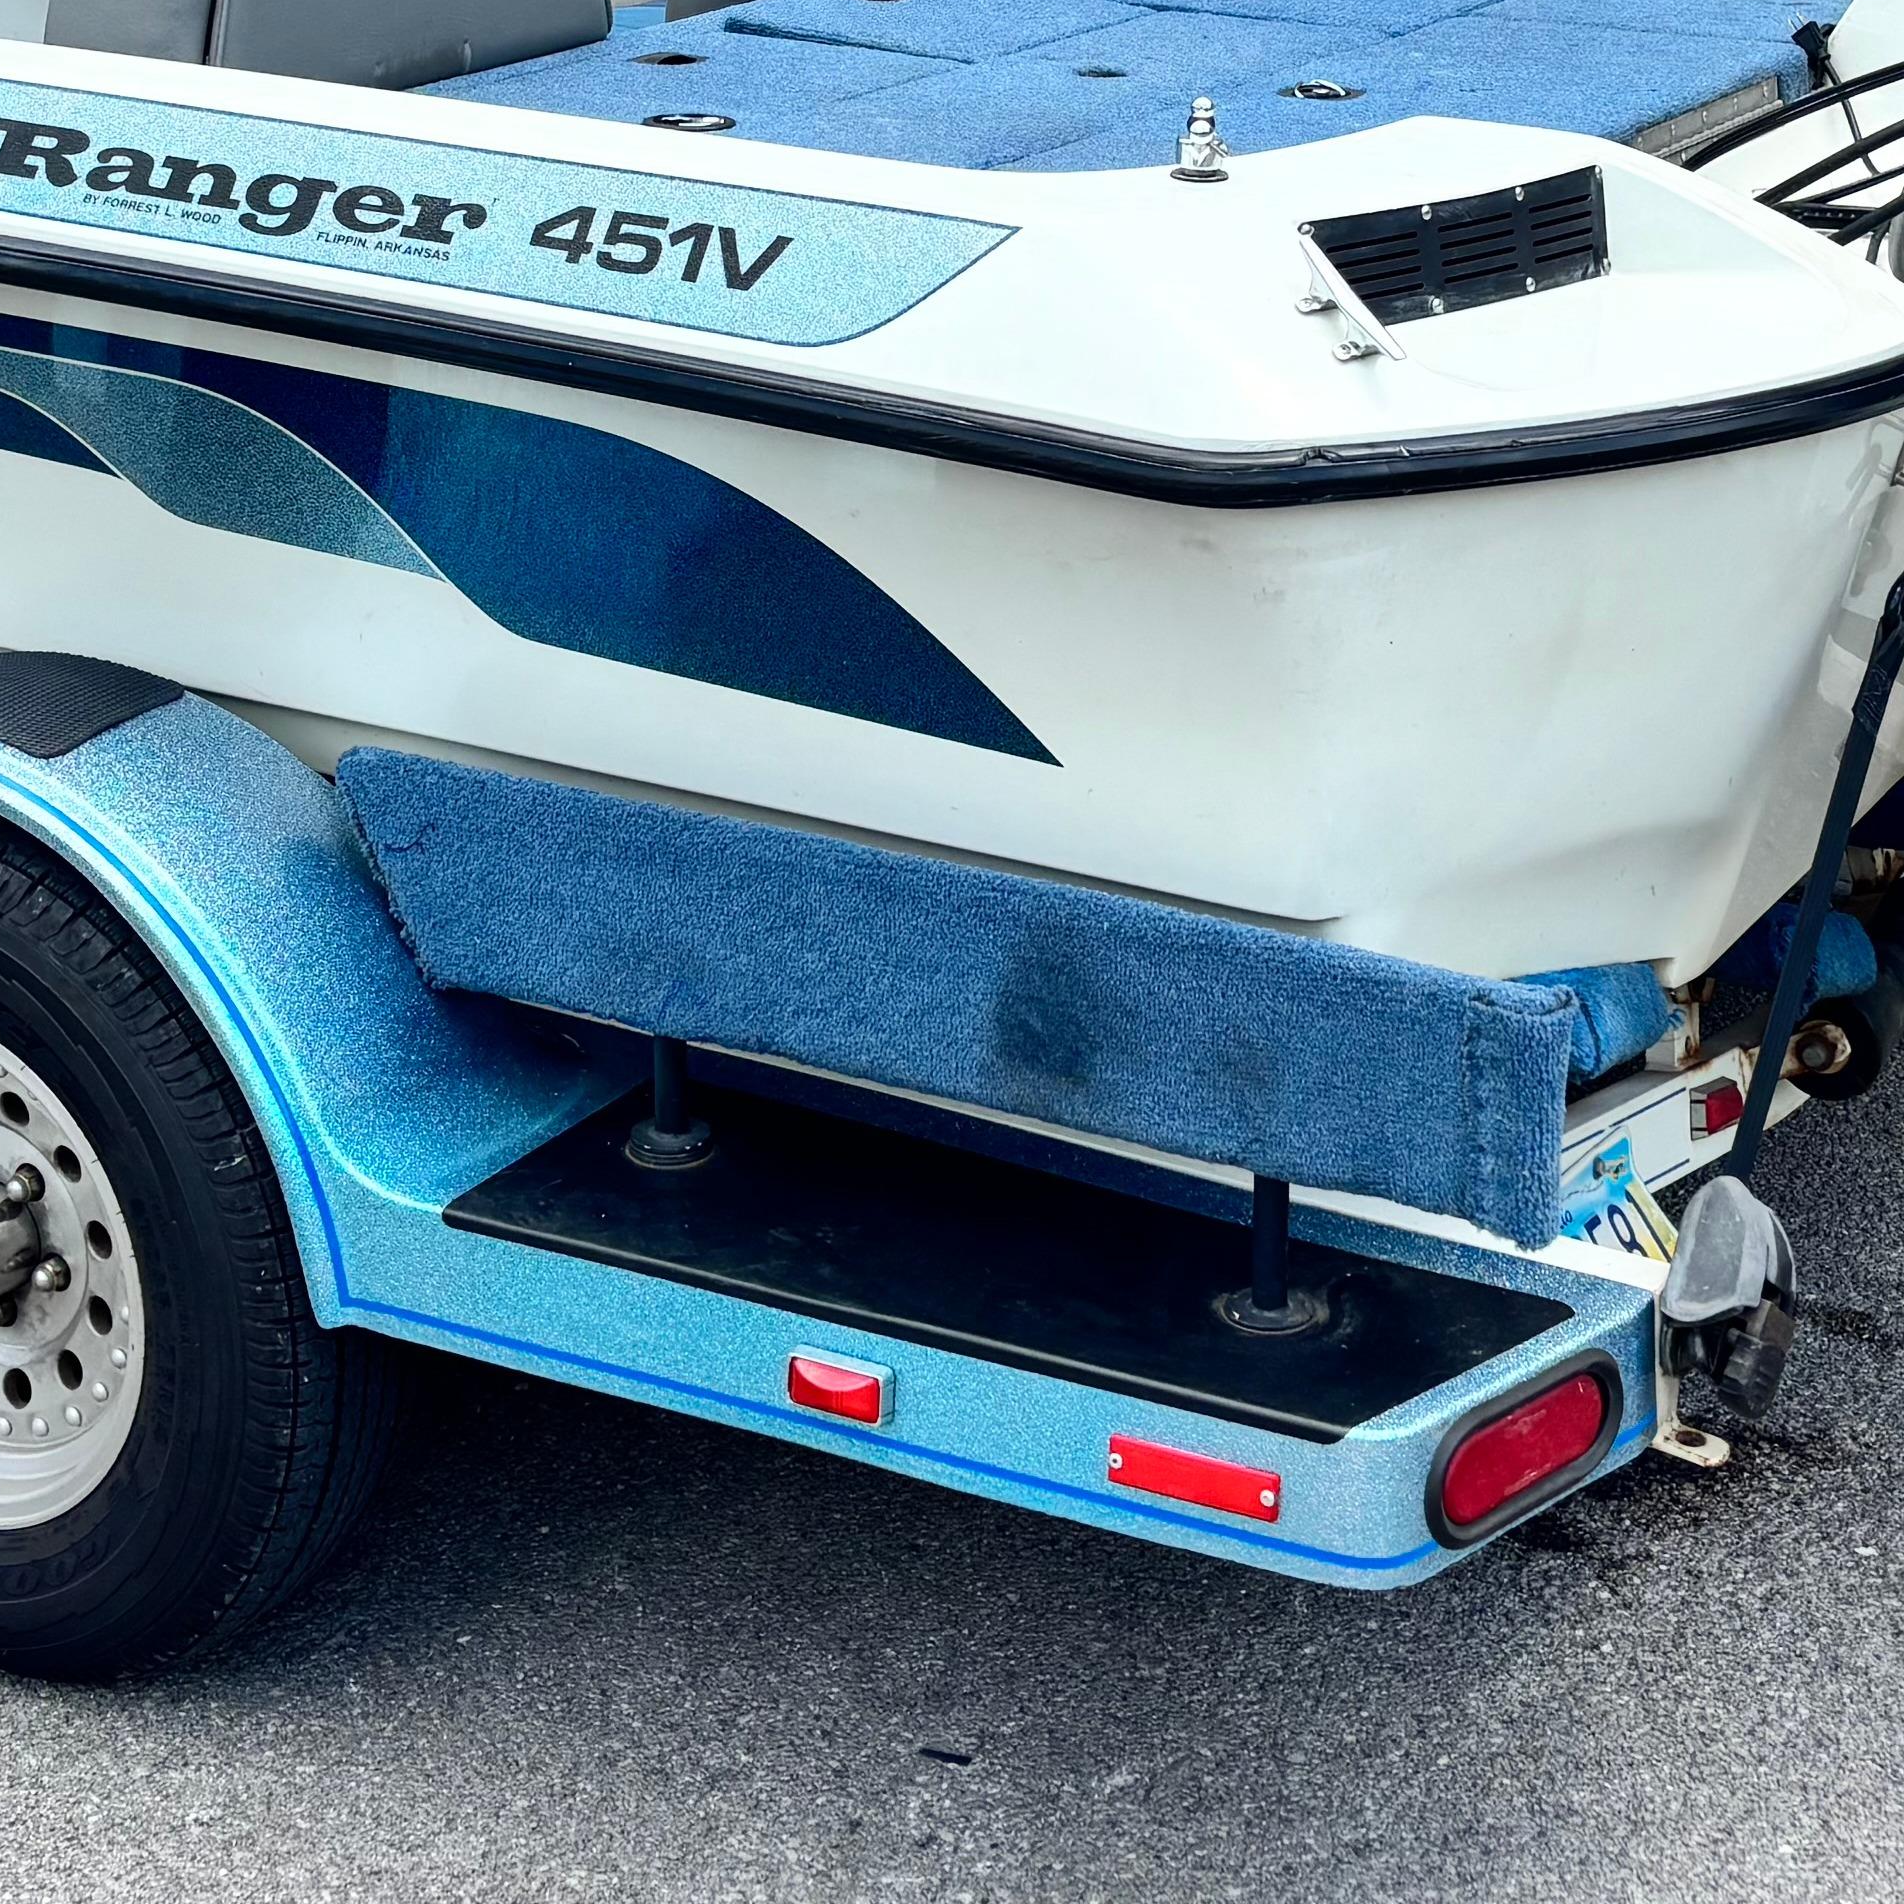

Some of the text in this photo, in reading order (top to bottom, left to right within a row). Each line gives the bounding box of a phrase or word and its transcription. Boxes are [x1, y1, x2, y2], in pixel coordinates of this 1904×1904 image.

[82, 192, 223, 225] BY FORREST L. WOOD
[374, 240, 451, 263] ARKANSAS
[529, 205, 794, 293] 451V
